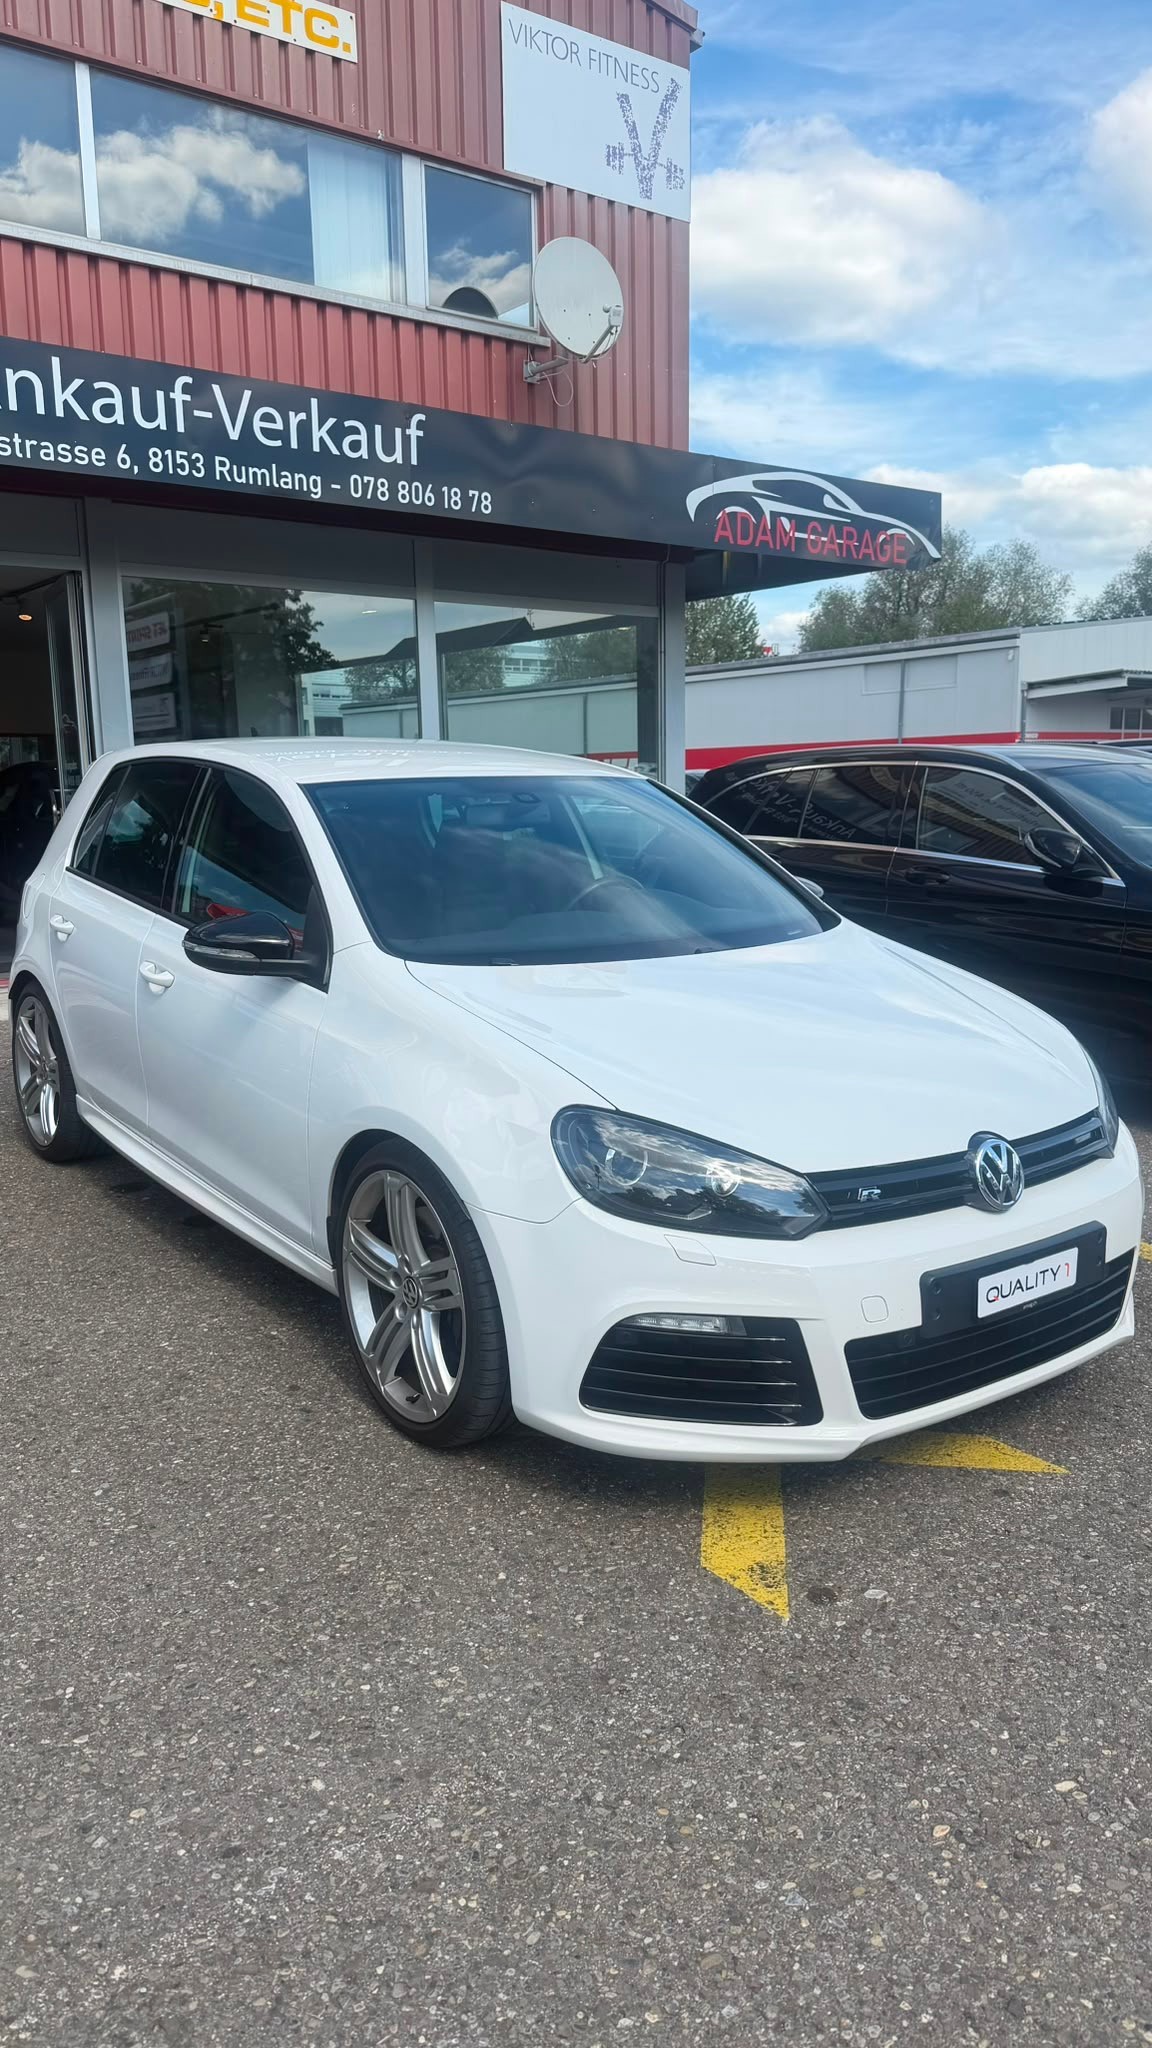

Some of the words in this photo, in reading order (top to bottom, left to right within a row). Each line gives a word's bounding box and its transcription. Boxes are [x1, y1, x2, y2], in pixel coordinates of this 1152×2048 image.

[236, 0, 352, 54] ETC.
[508, 18, 582, 68] VIKTOR
[588, 47, 660, 94] FITNESS
[0, 355, 426, 466] nkauf-Verkauf
[116, 443, 139, 476] 6,
[148, 447, 206, 479] 8153
[214, 455, 322, 499] Rumlang
[350, 474, 389, 501] 078
[397, 480, 435, 507] 806
[441, 485, 462, 511] 18
[468, 489, 492, 515] 78
[714, 509, 796, 553] ADAM
[806, 520, 908, 565] GARAGE
[985, 1264, 1061, 1304] QUALITY
[1064, 1262, 1071, 1278] 1
